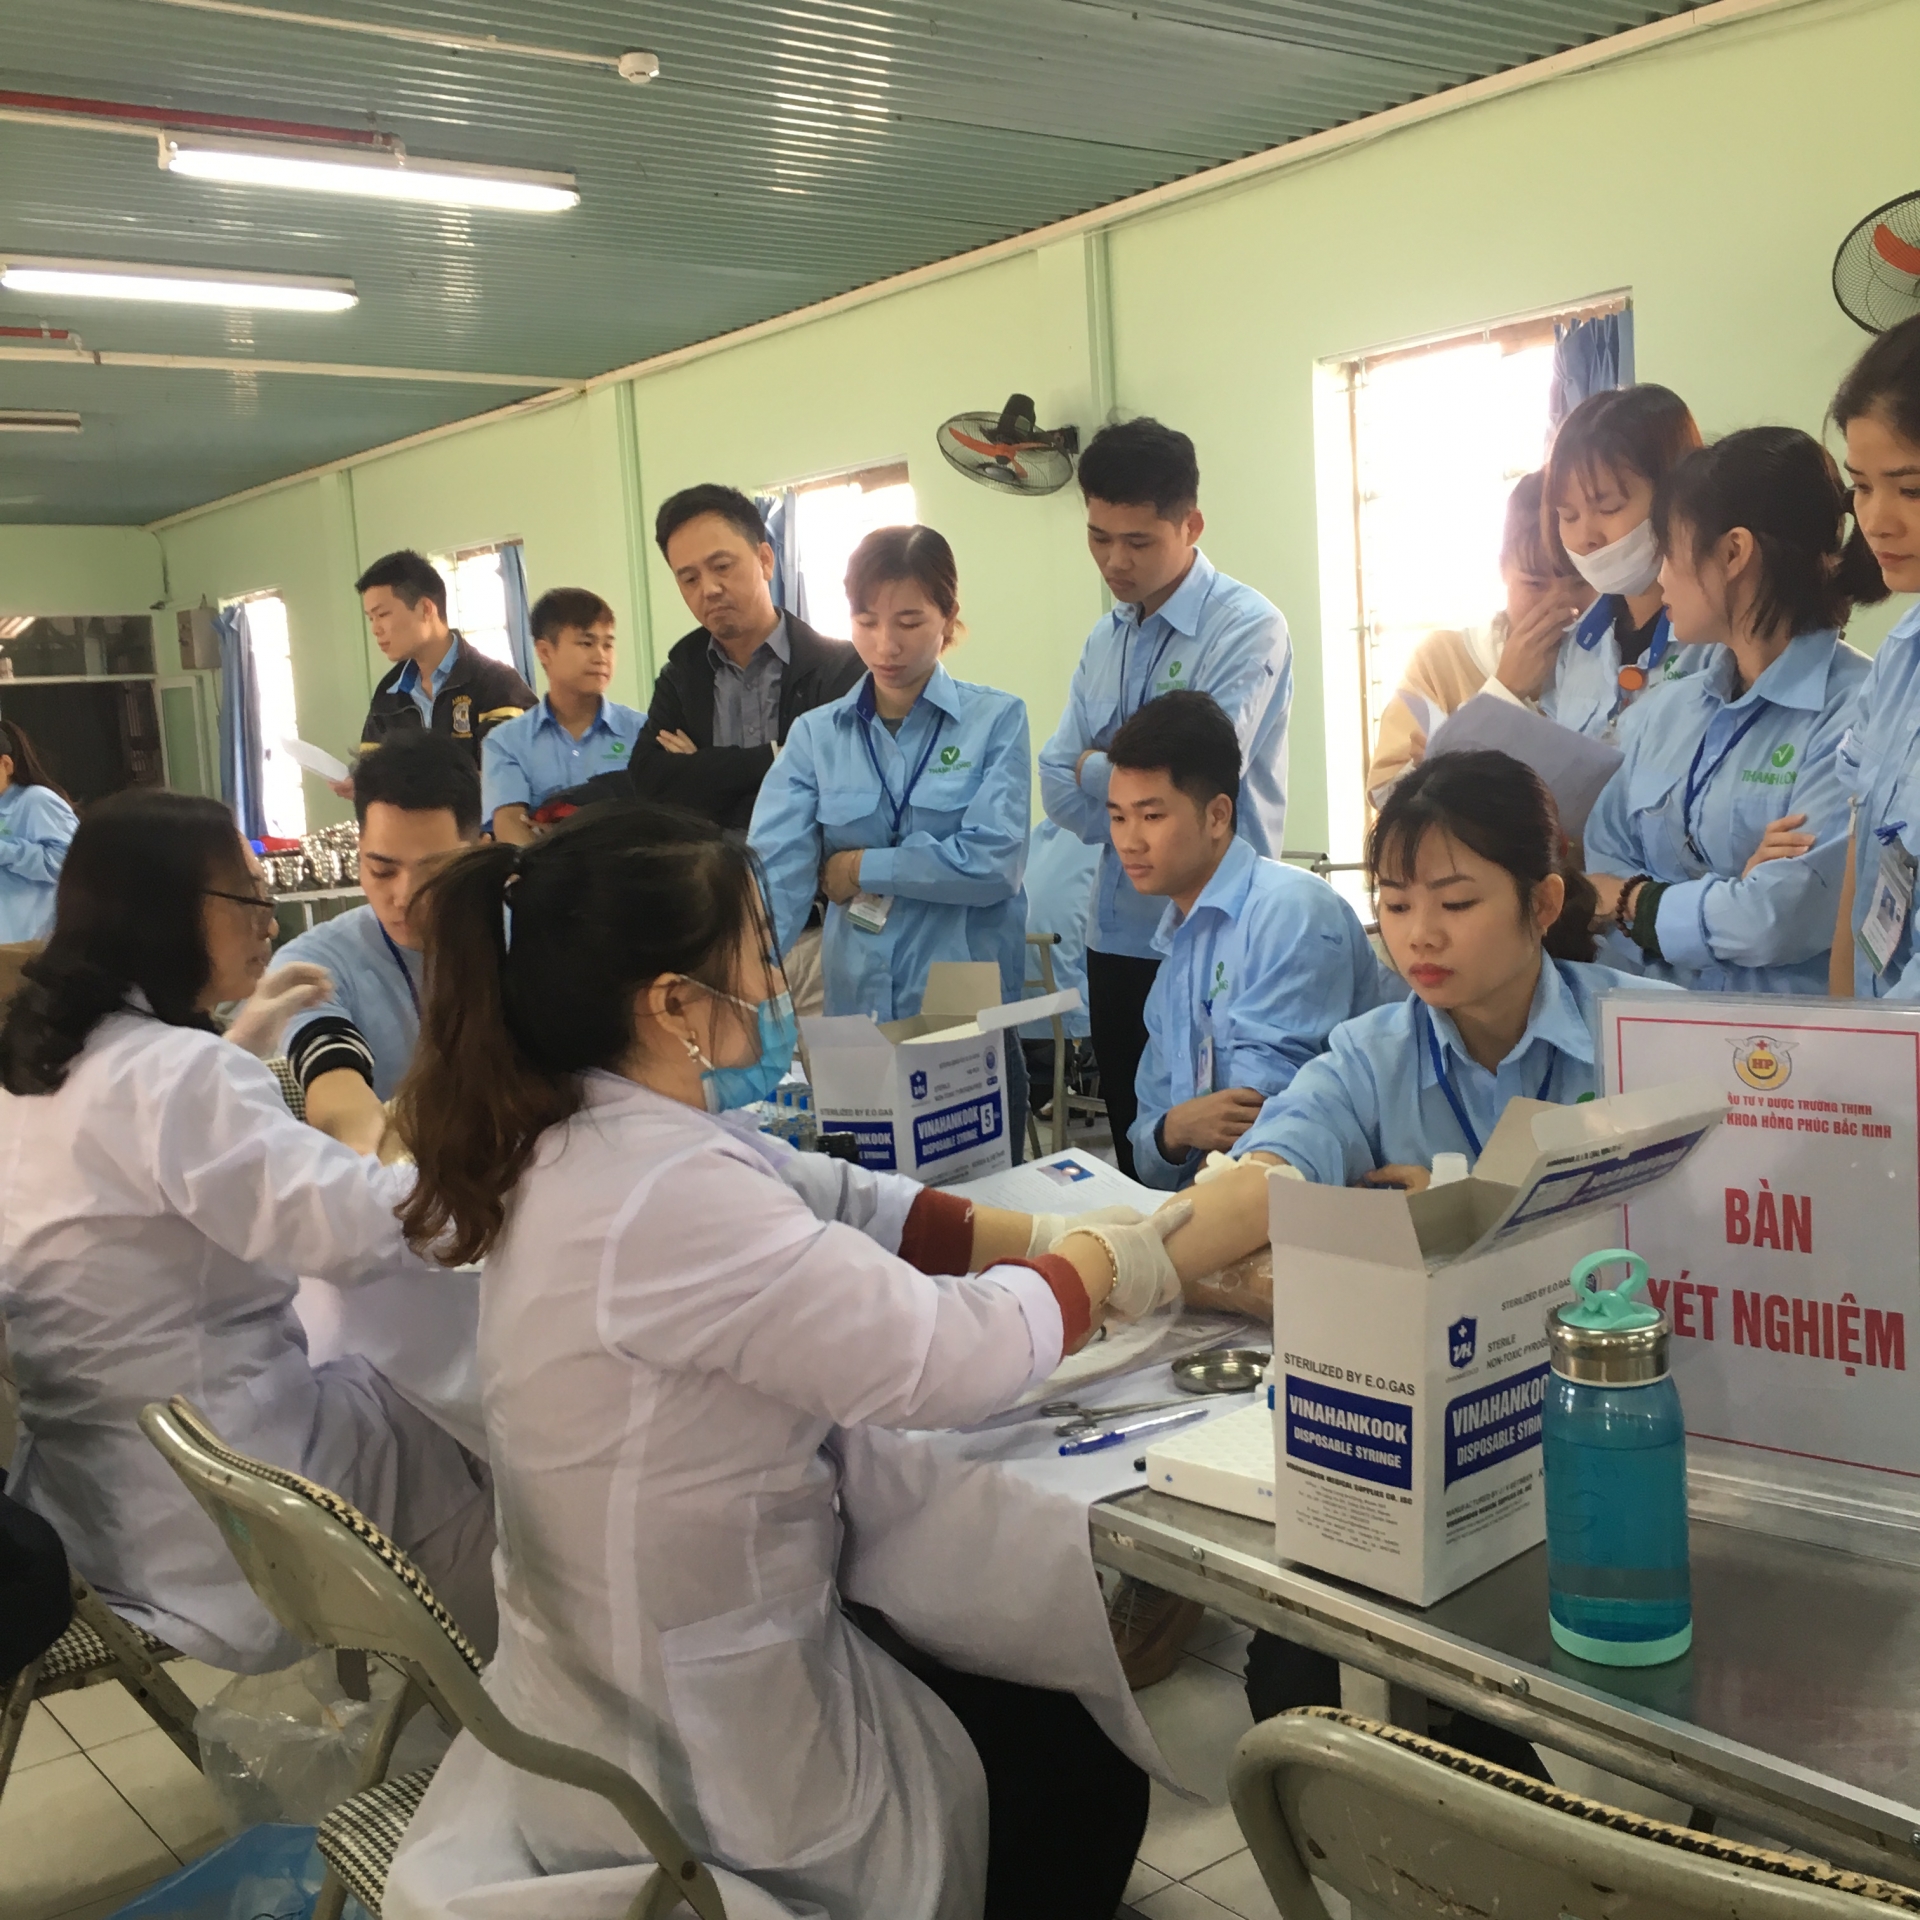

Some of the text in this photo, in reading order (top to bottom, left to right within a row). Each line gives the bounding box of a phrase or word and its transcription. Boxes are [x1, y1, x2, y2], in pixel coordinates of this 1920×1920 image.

[1752, 1058, 1774, 1070] HP
[855, 1108, 864, 1116] BY
[985, 1108, 991, 1128] 5
[1842, 1103, 1872, 1117] THỊNH
[1727, 1111, 1892, 1138] KHOA HỒNG PHÚC BẮC NINH
[1725, 1178, 1812, 1254] BÀN
[1501, 1290, 1538, 1311] STERILIZED
[1538, 1286, 1547, 1298] BY
[1487, 1333, 1516, 1353] STERILE
[1732, 1289, 1906, 1377] NGHIỆM
[1486, 1348, 1522, 1370] NON-TOXIC
[1284, 1352, 1415, 1396] STERILIZED BY E.O.GAS
[1452, 1374, 1549, 1437] VINAHANKOO
[1289, 1394, 1407, 1445] VINAHANKOOK
[1294, 1426, 1402, 1469] DISPOSABLE SYRINGE
[1457, 1414, 1542, 1466] DISPOSABLE SYRIN
